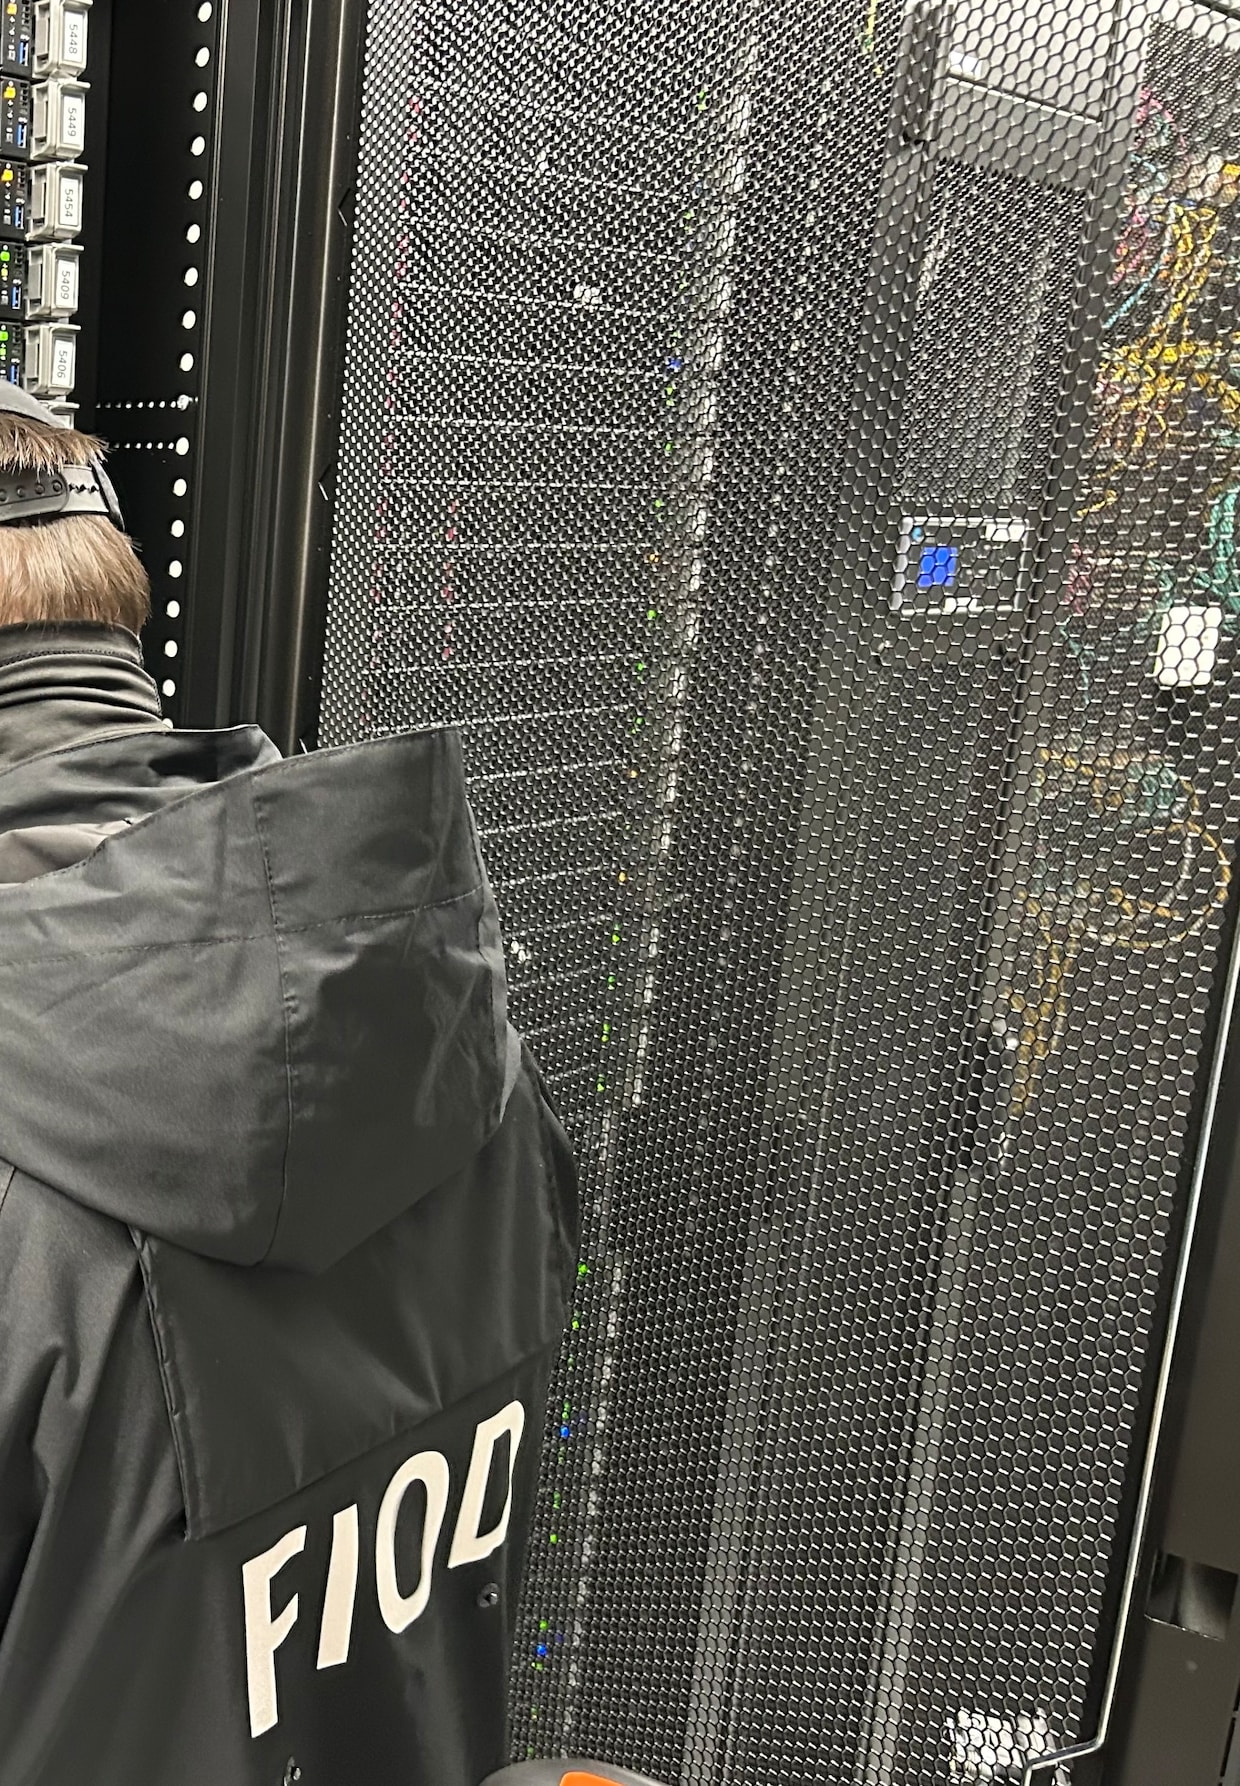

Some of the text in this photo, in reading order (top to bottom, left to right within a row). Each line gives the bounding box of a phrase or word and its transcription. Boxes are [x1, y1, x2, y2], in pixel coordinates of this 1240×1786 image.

[68, 24, 79, 55] 5448
[67, 107, 77, 137] 5449
[64, 188, 74, 218] 5454
[60, 270, 71, 300] 5409
[56, 350, 68, 379] 5406
[242, 1400, 525, 1738] FIOD
